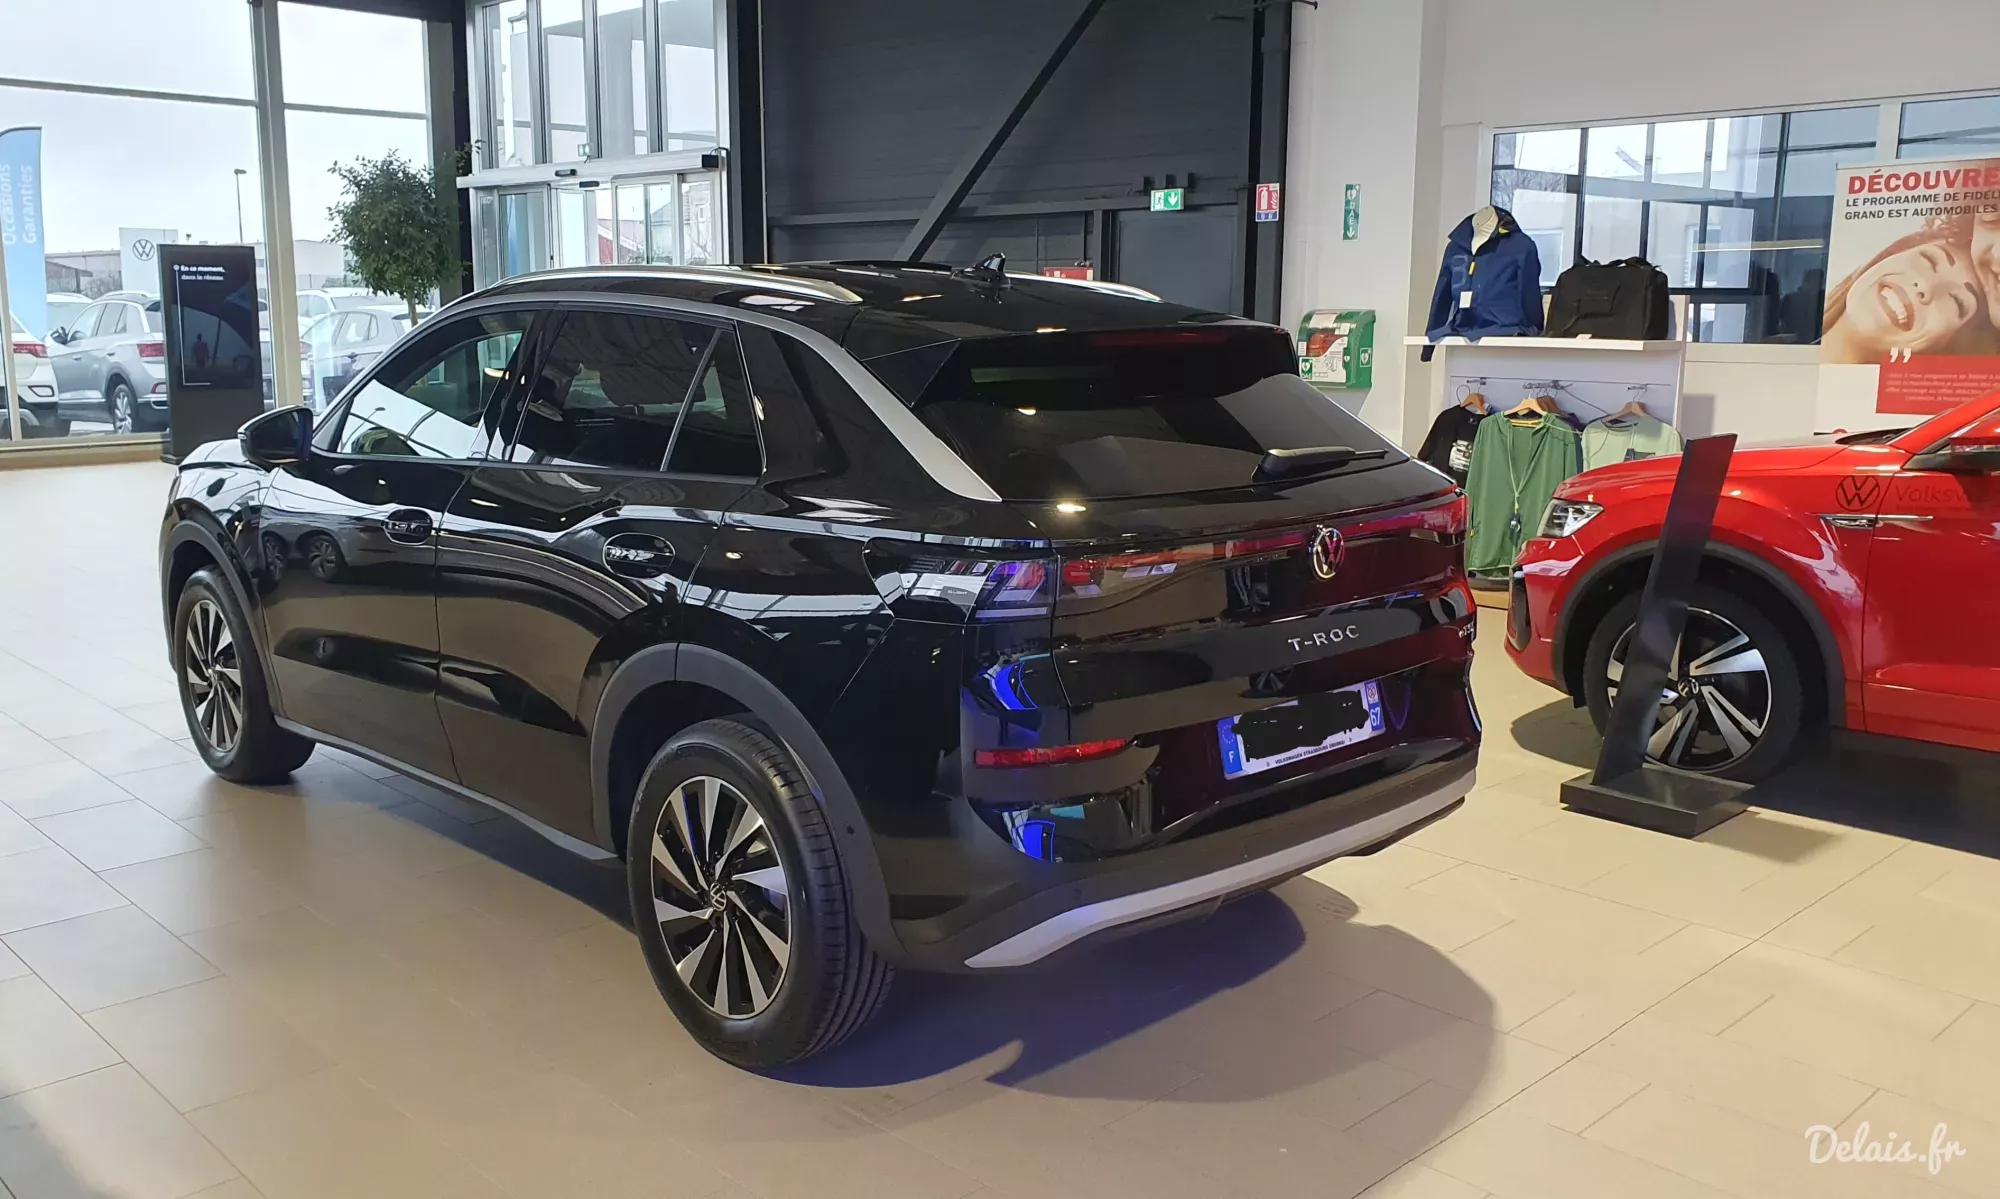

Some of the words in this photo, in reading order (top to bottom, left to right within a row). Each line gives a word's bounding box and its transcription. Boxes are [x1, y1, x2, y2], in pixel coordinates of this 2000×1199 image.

[1848, 167, 2000, 194] DÉCOUVRE
[0, 164, 16, 245] Occasions
[20, 165, 37, 244] Garanties
[1846, 198, 1859, 207] LE
[1862, 193, 1940, 206] PROGRAMME
[1944, 192, 1960, 202] DE
[1845, 210, 1884, 220] GRAND
[1888, 209, 1910, 218] EST
[1912, 204, 1997, 217] AUTOMOBILES
[1288, 625, 1359, 651] T-ROC
[1370, 707, 1381, 727] 67
[1228, 751, 1235, 764] F
[1275, 753, 1303, 765] VOLKSWAGEN
